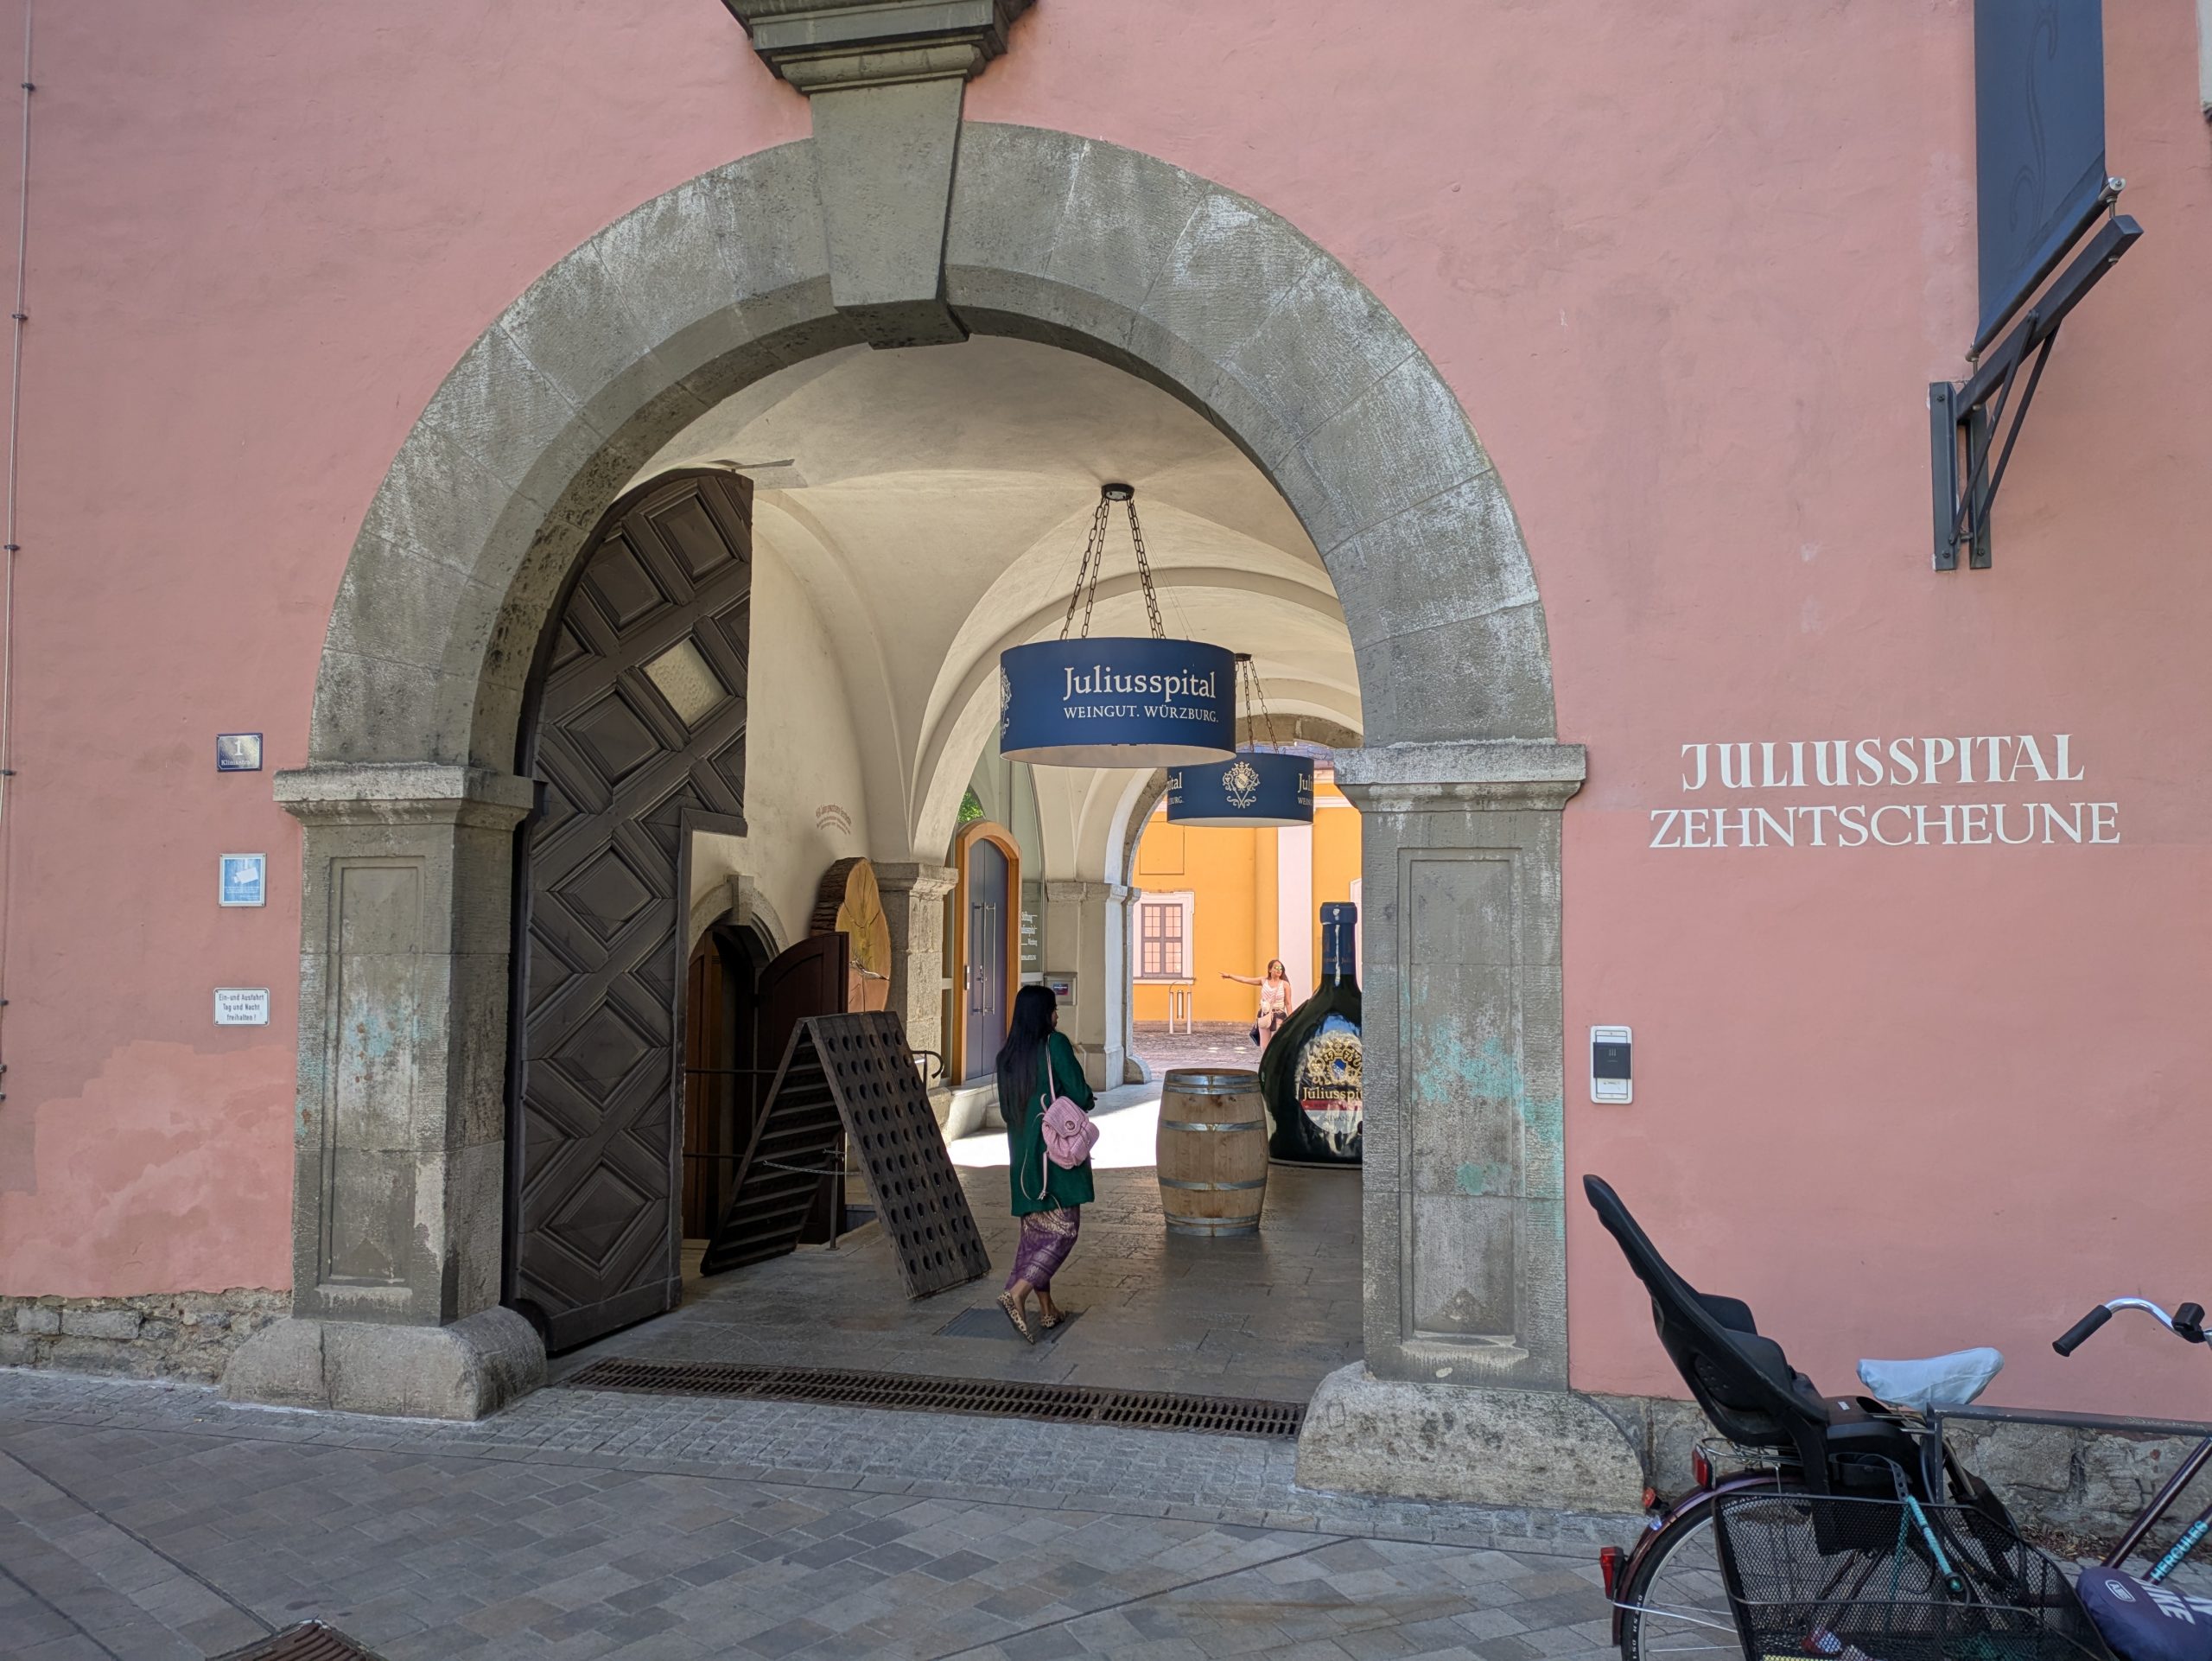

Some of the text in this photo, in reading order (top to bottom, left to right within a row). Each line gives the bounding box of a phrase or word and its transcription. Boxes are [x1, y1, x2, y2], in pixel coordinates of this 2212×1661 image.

[1063, 664, 1217, 703] Juliusspital
[1064, 704, 1218, 723] WEINGUT. WÜRZBURG.
[234, 740, 243, 756] 1
[1681, 734, 2085, 792] JULIUSSPITAL
[1649, 802, 2121, 849] ZEHNTSCHEUNE
[223, 1003, 232, 1012] Tag
[2150, 1520, 2209, 1581] HERCULES
